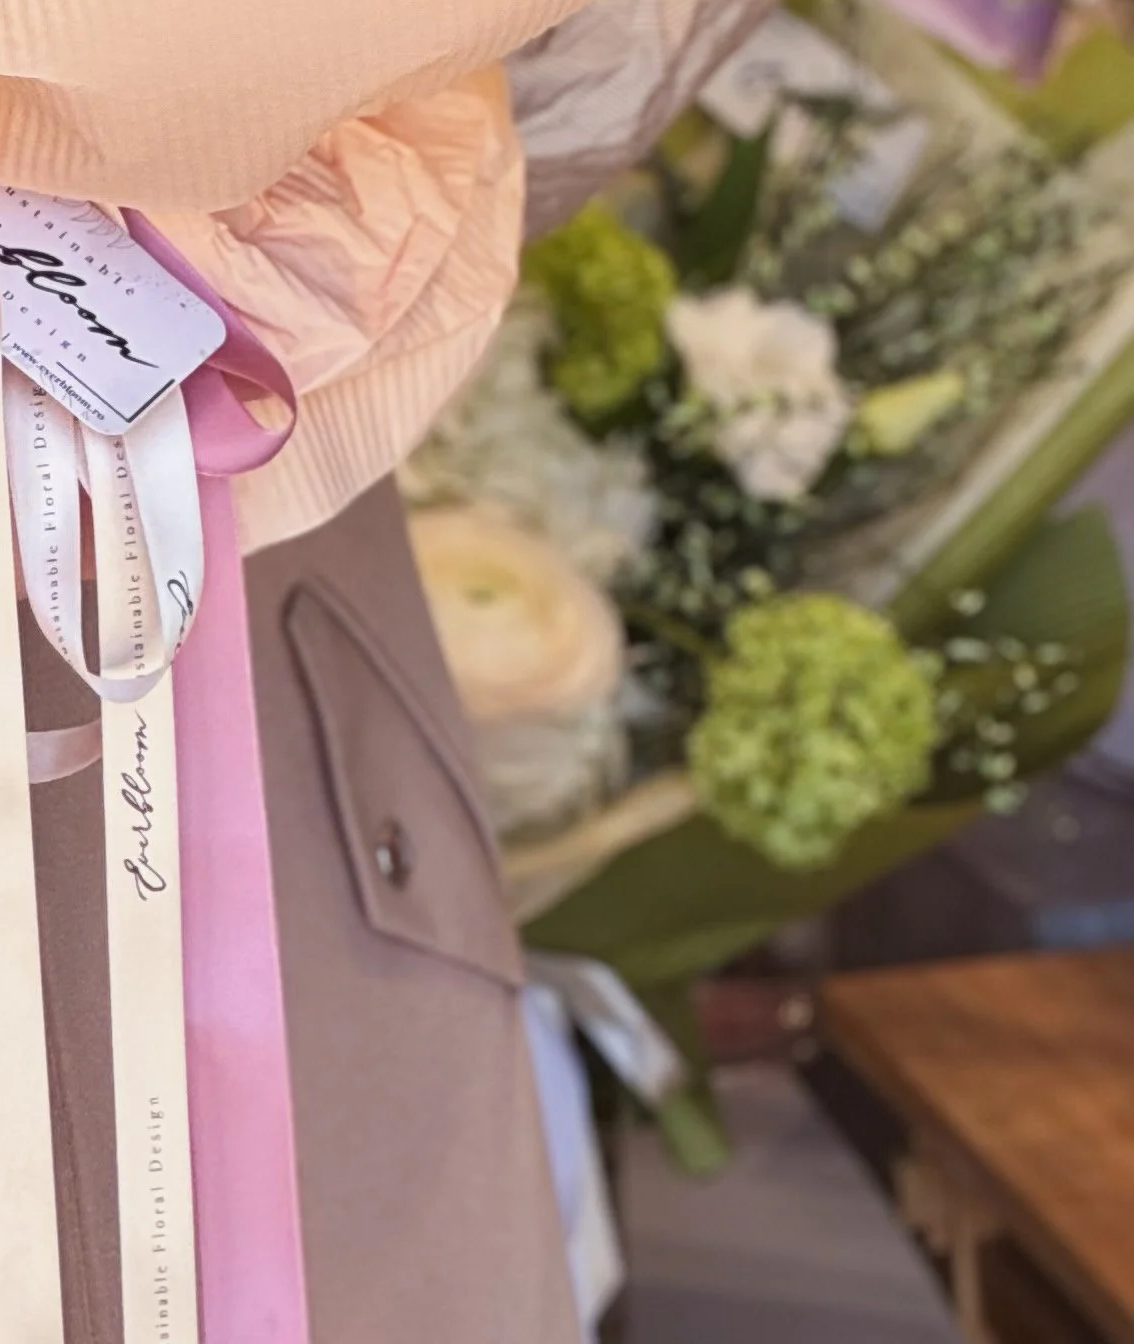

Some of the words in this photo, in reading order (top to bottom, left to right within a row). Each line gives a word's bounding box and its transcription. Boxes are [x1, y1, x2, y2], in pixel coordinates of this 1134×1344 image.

[4, 185, 136, 298] ustainable
[2, 289, 88, 363] Design
[36, 463, 57, 532] Floral
[119, 492, 139, 561] Floral
[121, 708, 167, 901] Everbloom
[147, 1096, 165, 1173] Design
[150, 1186, 167, 1254] Floral
[153, 1265, 171, 1344] ainable
